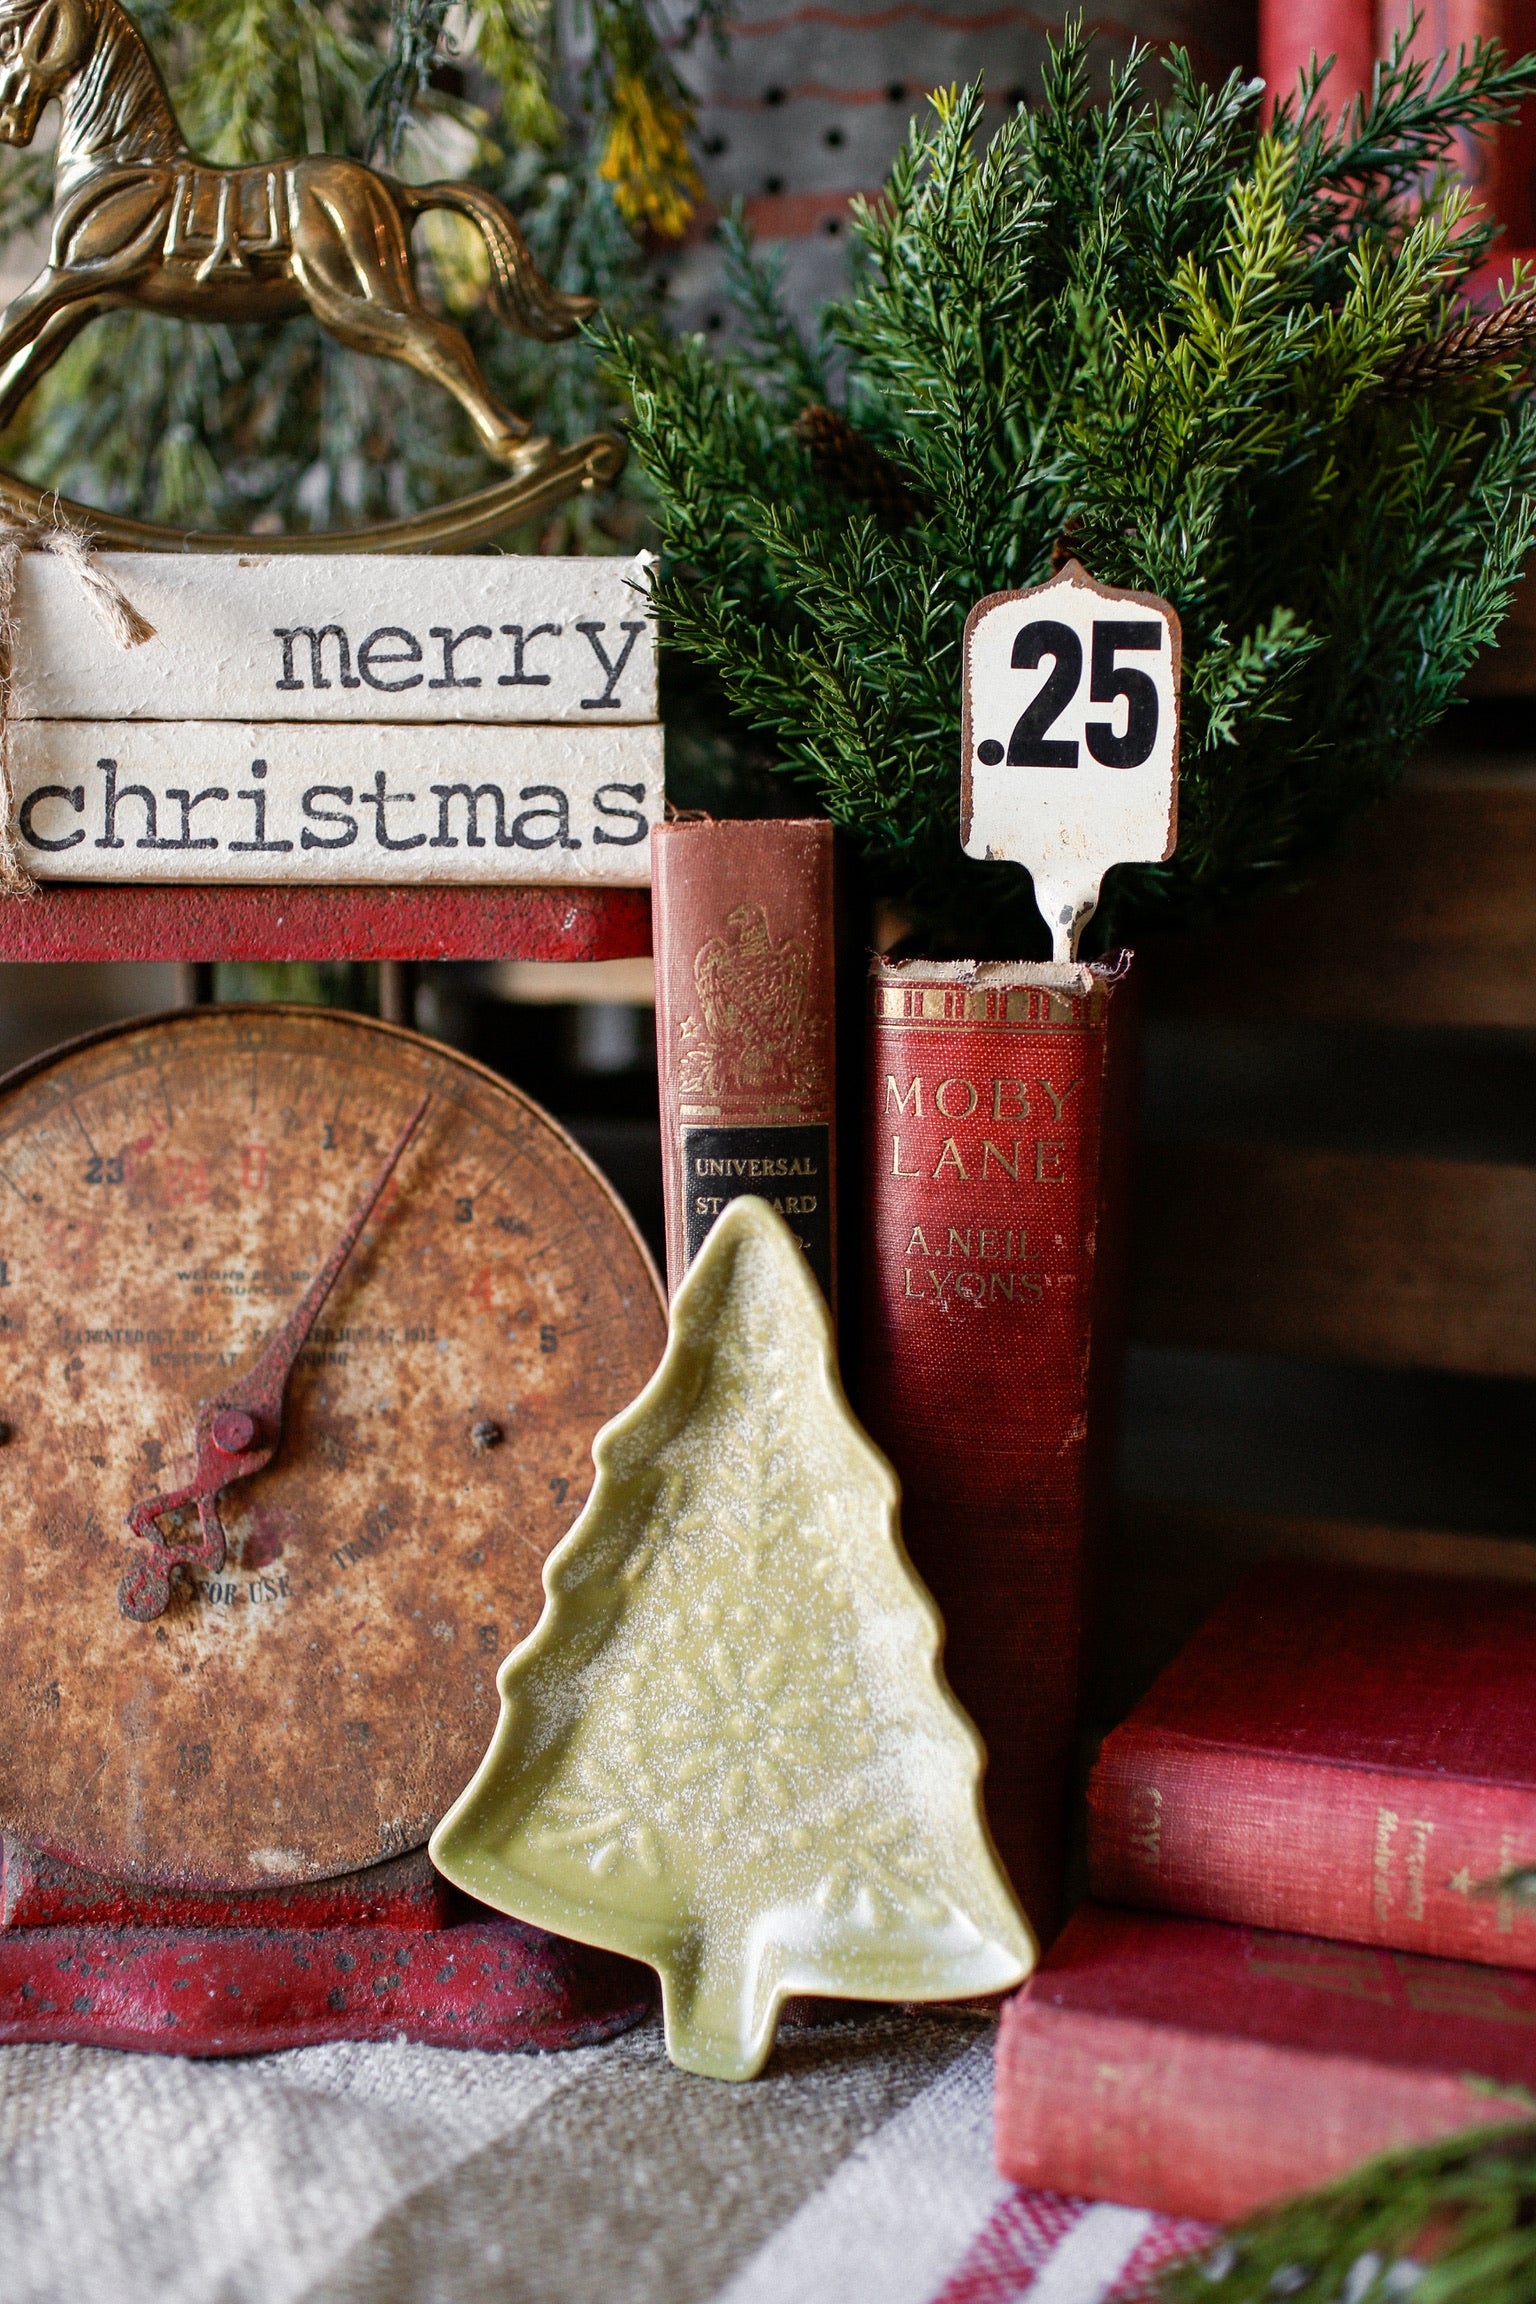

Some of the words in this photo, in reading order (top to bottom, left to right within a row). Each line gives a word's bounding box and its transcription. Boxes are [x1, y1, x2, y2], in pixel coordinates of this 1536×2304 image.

[273, 620, 646, 709] merry
[977, 620, 1162, 769] .25
[18, 759, 650, 852] christmas
[884, 1074, 1083, 1121] MOBY
[86, 1157, 124, 1184] 23
[695, 1158, 818, 1177] UNIVERSAL
[890, 1136, 1065, 1183] LANE
[455, 1198, 473, 1223] 3
[695, 1195, 818, 1215] STARD
[904, 1268, 1043, 1301] LYONS
[540, 1325, 557, 1353] 5
[549, 1477, 569, 1506] 7
[200, 1581, 237, 1605] FOR
[249, 1574, 294, 1605] USE
